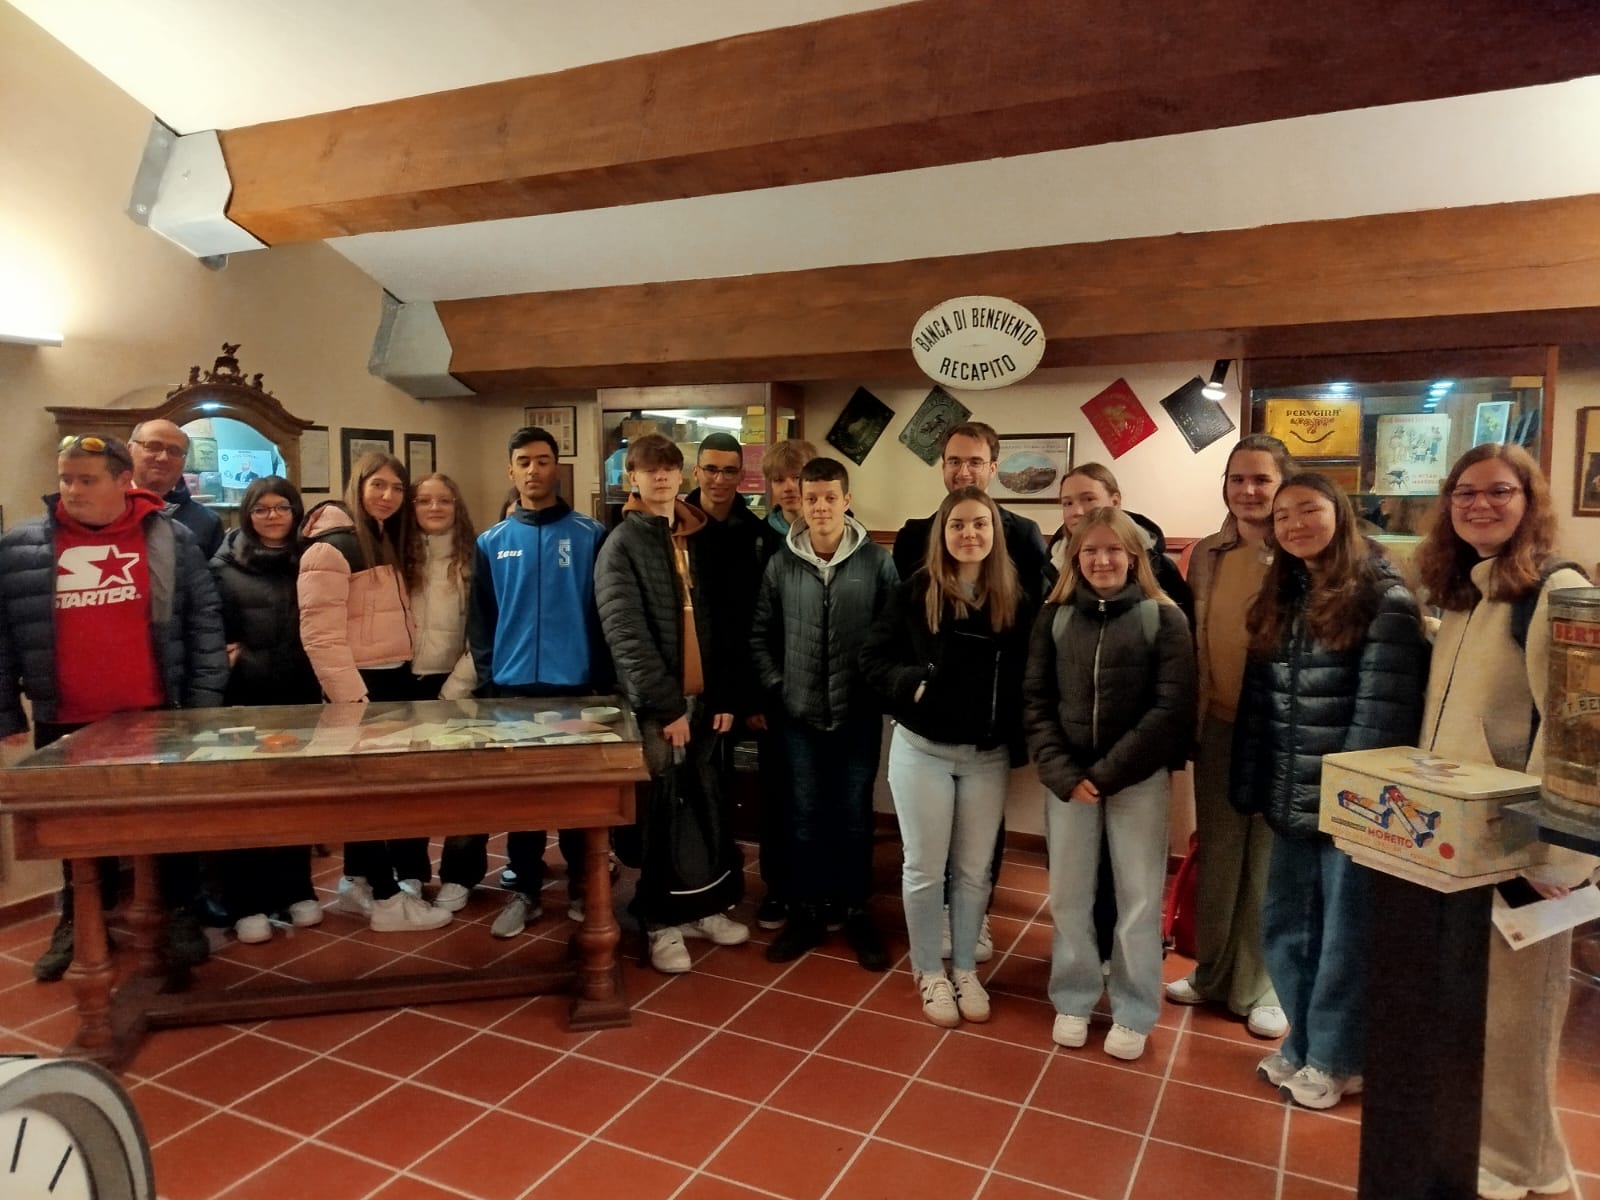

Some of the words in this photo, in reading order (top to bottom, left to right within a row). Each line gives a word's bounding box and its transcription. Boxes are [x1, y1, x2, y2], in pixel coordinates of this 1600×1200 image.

[915, 316, 952, 353] BANCA
[953, 309, 967, 331] DI
[972, 307, 1038, 346] BENEVENTO
[939, 354, 1016, 381] RECAPITO
[1367, 827, 1413, 849] MORETTO
